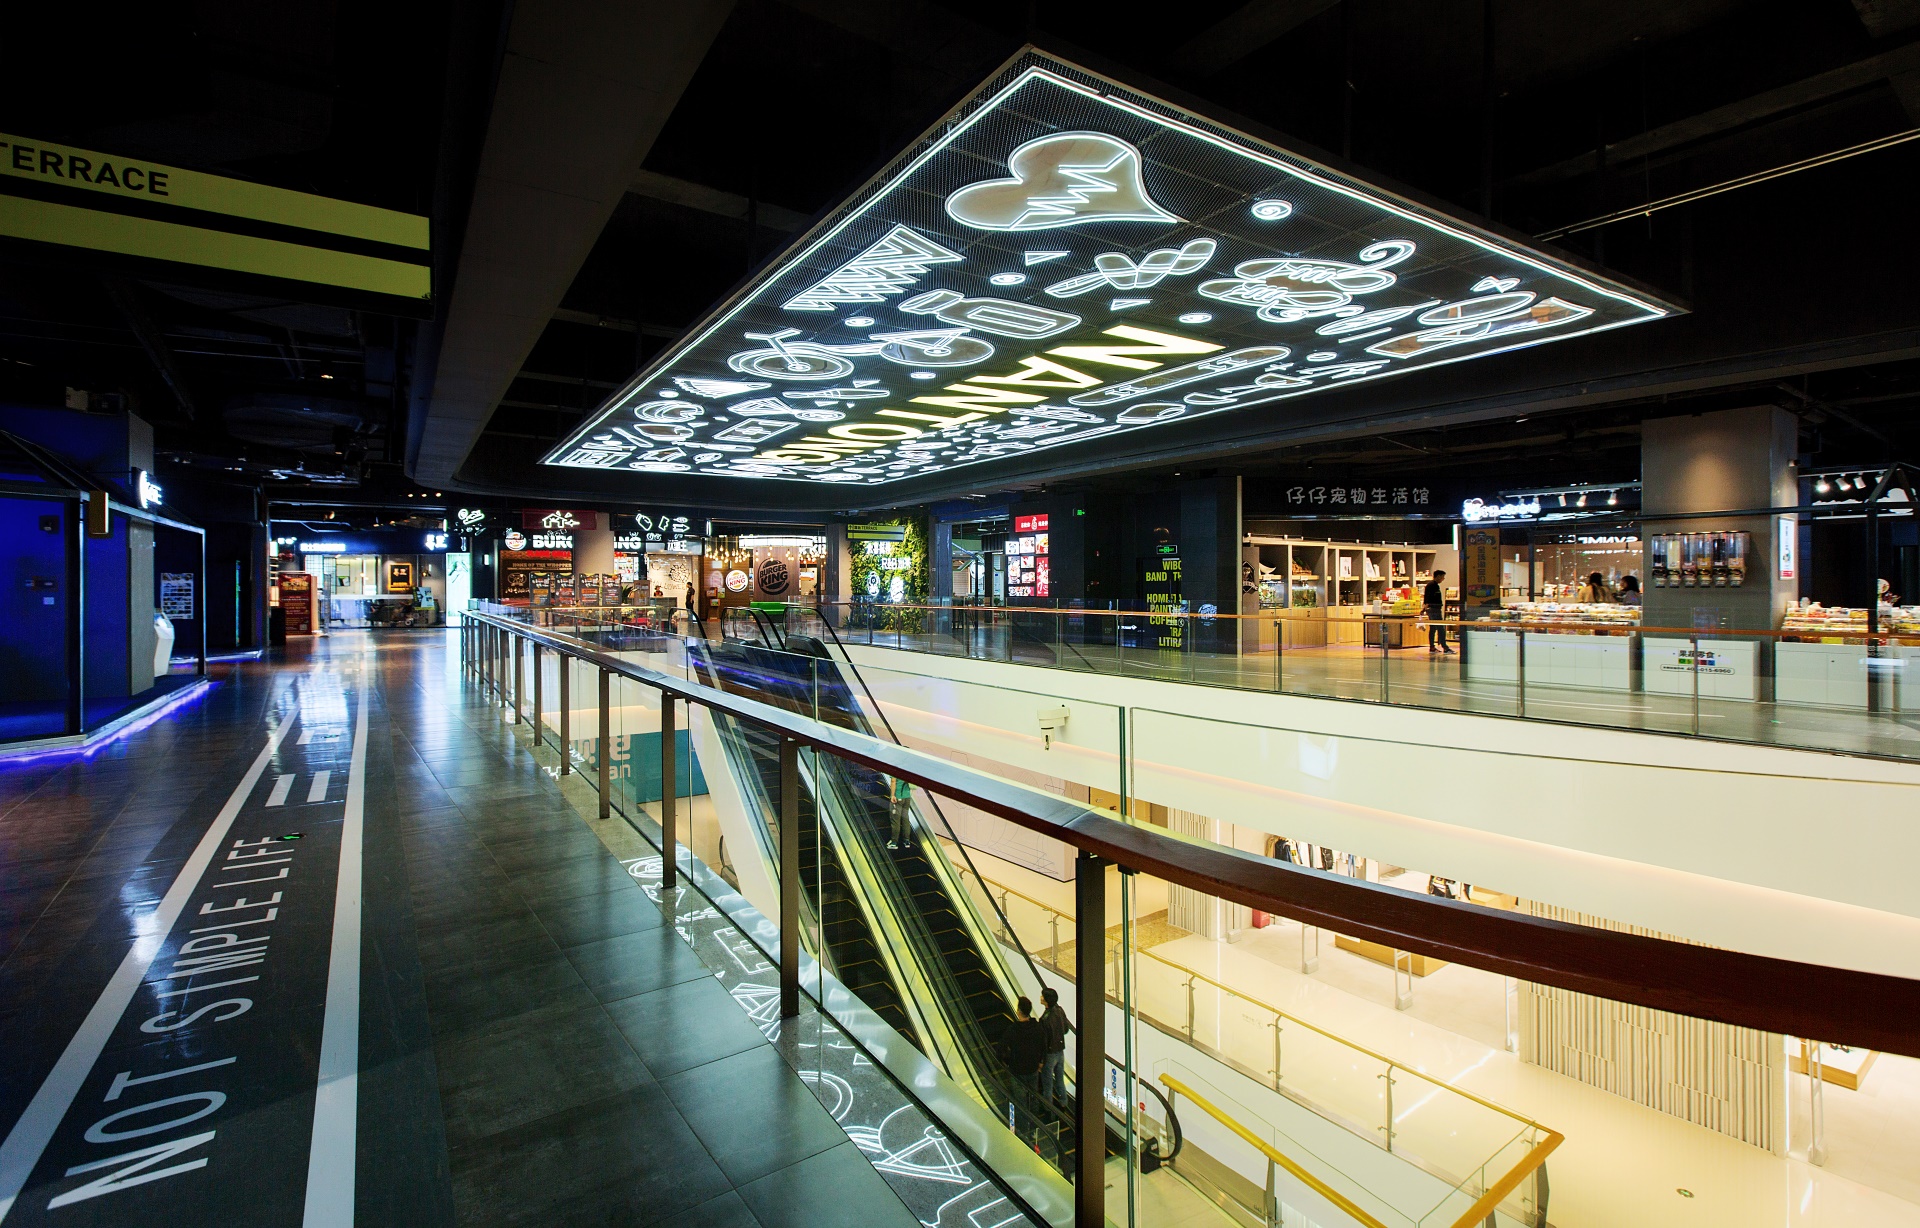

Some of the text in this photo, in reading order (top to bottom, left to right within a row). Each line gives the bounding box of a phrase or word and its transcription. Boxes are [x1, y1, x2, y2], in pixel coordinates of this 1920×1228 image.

[0, 142, 170, 197] ERRACE
[1286, 486, 1430, 505] 仔仔宠物生活馆
[759, 563, 787, 578] BURGER
[1145, 571, 1168, 582] BAND
[729, 577, 746, 587] KING
[761, 571, 789, 588] KING
[46, 835, 295, 1210] NOT SIMPLE LIFE
